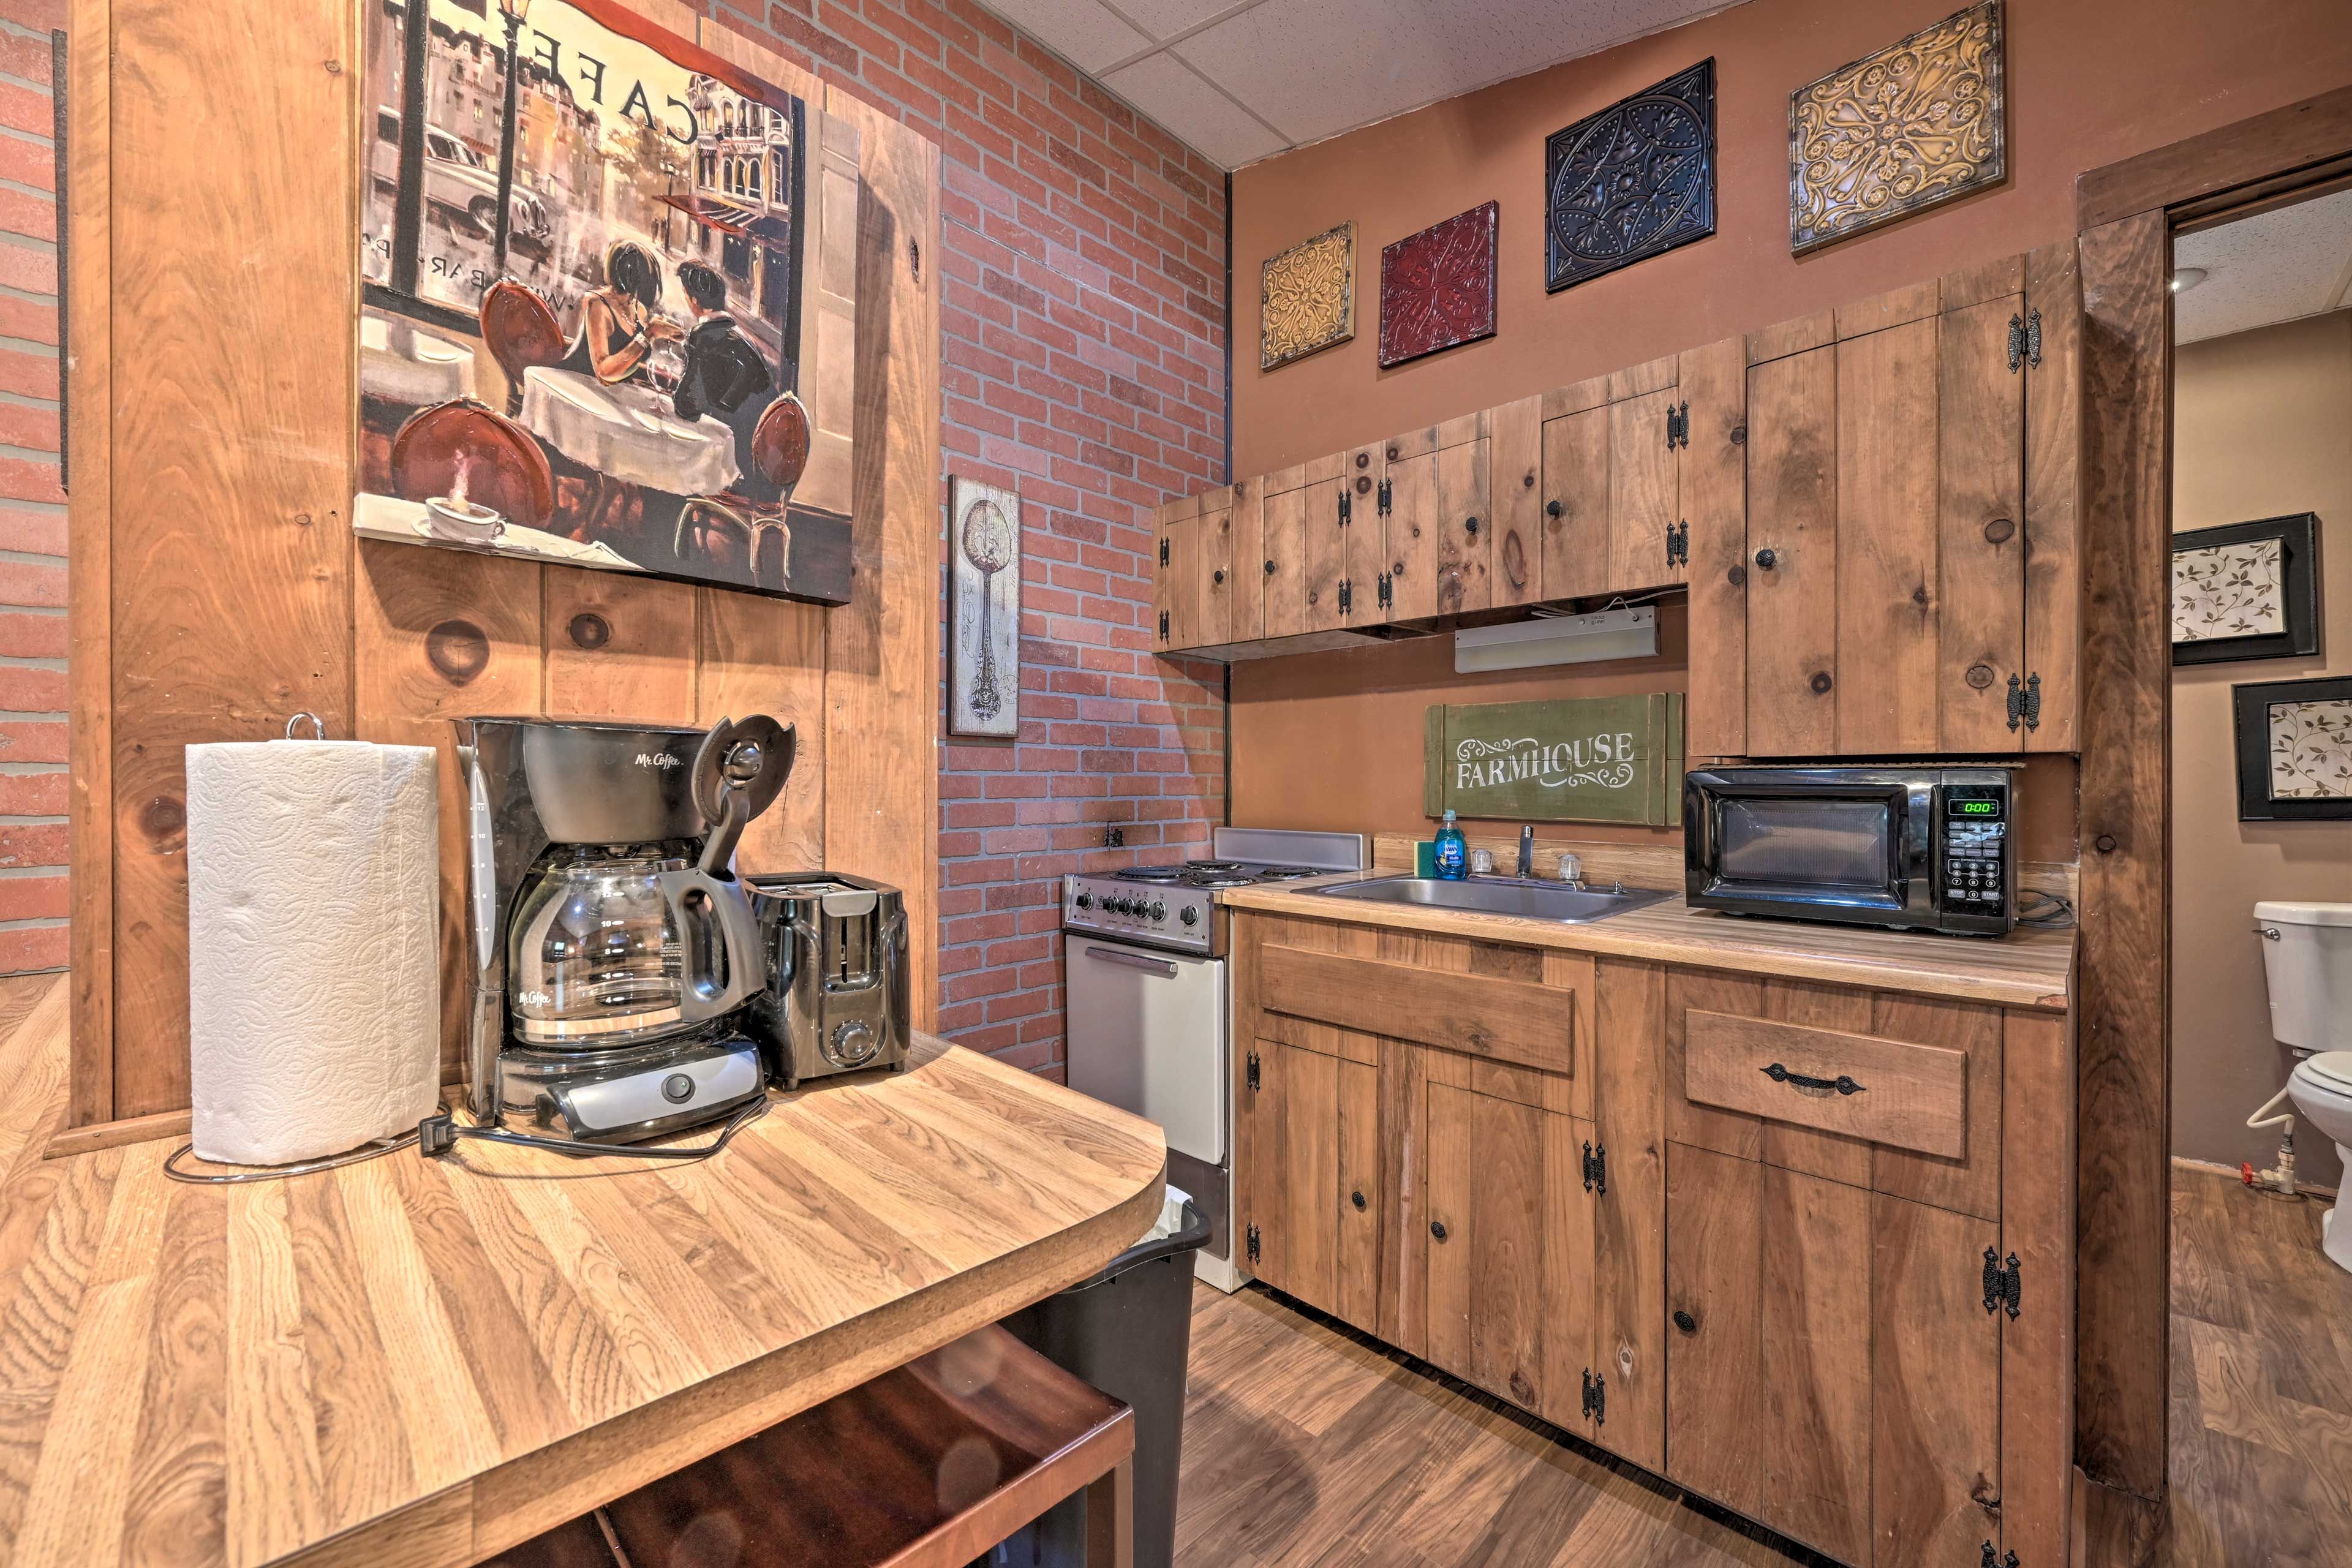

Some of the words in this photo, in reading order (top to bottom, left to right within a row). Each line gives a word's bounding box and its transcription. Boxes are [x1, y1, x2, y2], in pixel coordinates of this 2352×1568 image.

[635, 753, 652, 767] Mr.
[653, 753, 680, 770] Coffee
[1456, 733, 1635, 789] FARMHOUSE
[1965, 804, 1990, 812] 0:00
[529, 991, 551, 1008] Coffee
